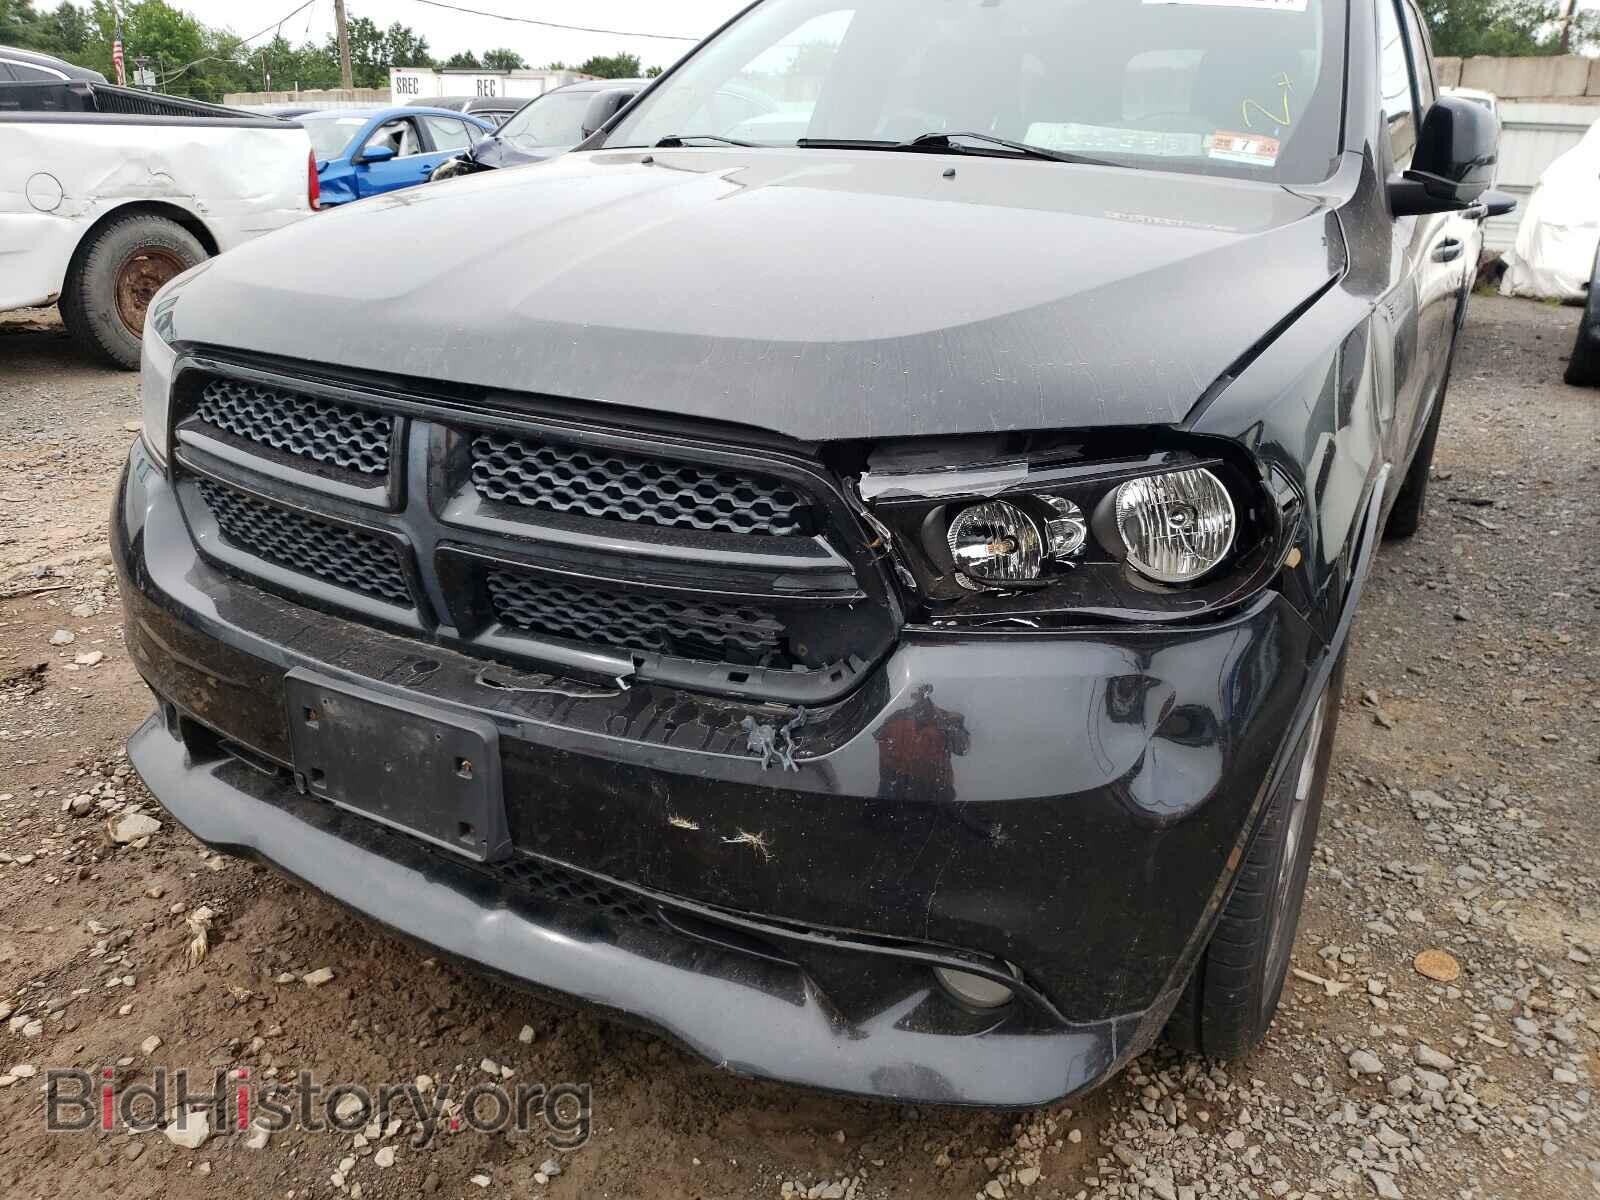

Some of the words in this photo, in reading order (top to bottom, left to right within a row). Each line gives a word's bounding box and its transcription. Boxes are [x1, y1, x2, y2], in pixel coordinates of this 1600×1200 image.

[396, 77, 418, 94] SREC
[477, 79, 496, 97] REC
[1241, 139, 1250, 151] 7
